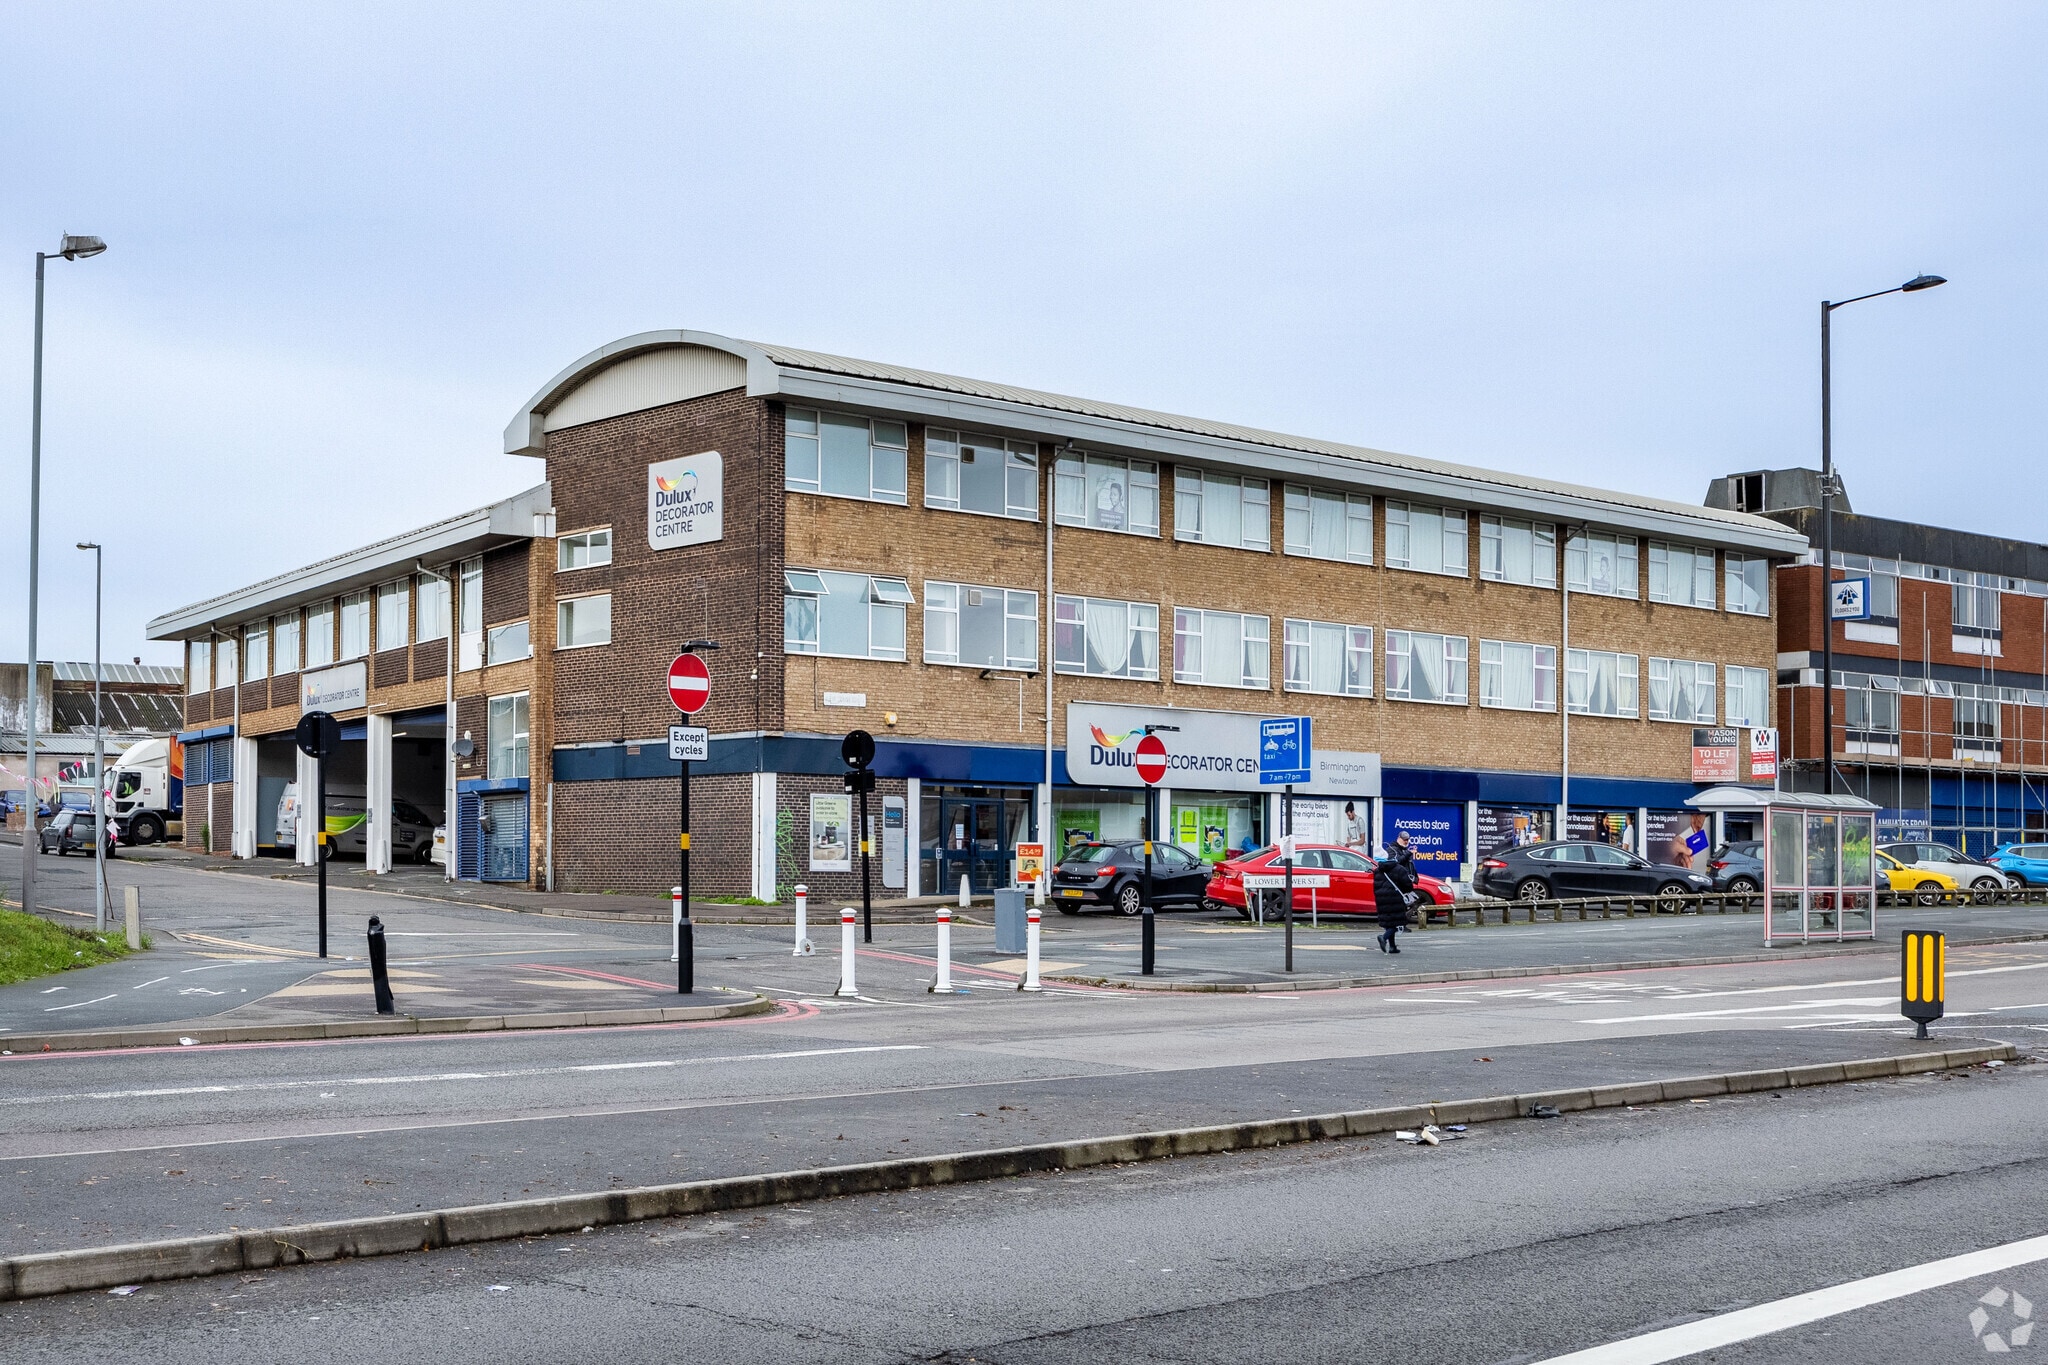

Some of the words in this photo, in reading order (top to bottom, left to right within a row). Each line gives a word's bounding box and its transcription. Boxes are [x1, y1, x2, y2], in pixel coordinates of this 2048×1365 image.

[656, 490, 692, 507] Dulux
[656, 501, 714, 522] DECORATOR
[656, 520, 693, 537] CENTRE
[307, 695, 320, 706] Dulux
[322, 691, 345, 703] DECORATOR
[345, 688, 360, 699] CENTRE
[673, 731, 705, 744] Except
[1707, 729, 1736, 737] MASON
[674, 745, 703, 756] cycles
[1699, 749, 1711, 758] TO
[1713, 749, 1730, 758] LET
[1166, 754, 1233, 772] ECORATOR
[1236, 758, 1260, 773] CEN
[1320, 761, 1366, 773] Birmingham
[1328, 777, 1358, 785] Newtown
[1300, 802, 1314, 810] early
[1314, 802, 1328, 810] birds
[1302, 811, 1315, 819] night
[1478, 816, 1497, 824] ne-stop
[1394, 818, 1422, 829] Access
[1422, 819, 1431, 829] to
[1431, 820, 1450, 830] store
[1478, 824, 1498, 832] hoppers
[1409, 835, 1432, 845] cated
[1432, 837, 1443, 845] on
[1412, 850, 1435, 860] Tower
[1435, 850, 1458, 860] Street
